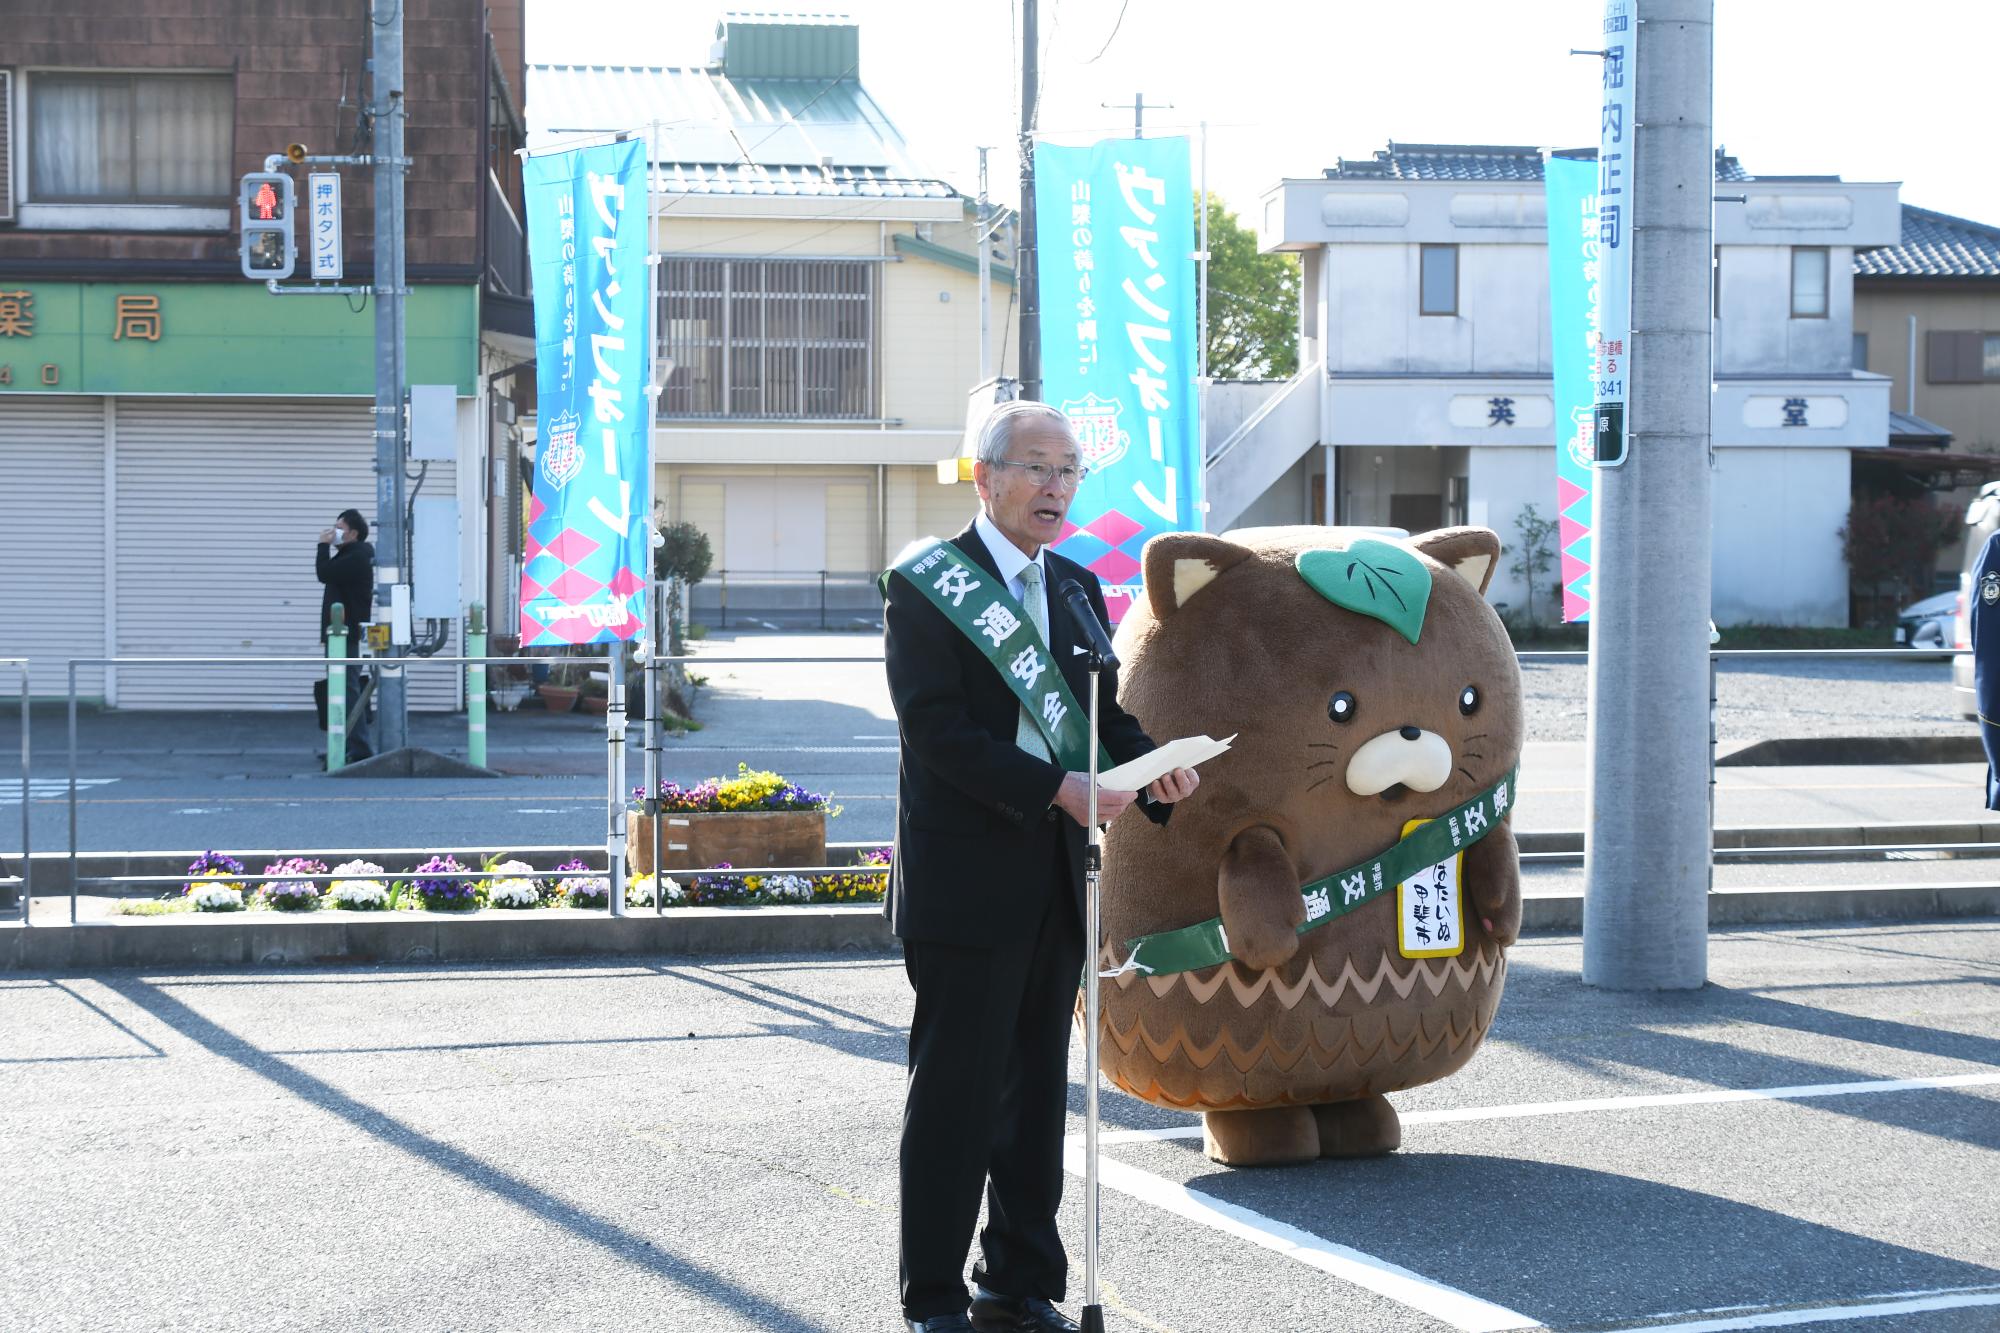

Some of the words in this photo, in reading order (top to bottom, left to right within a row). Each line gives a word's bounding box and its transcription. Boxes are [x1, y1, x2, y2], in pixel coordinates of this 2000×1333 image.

[317, 184, 334, 268] 押ボタン式
[1487, 398, 1515, 426] 英
[1781, 398, 1809, 427] 堂
[912, 547, 948, 575] 甲斐市
[933, 563, 1068, 733] 交通安全
